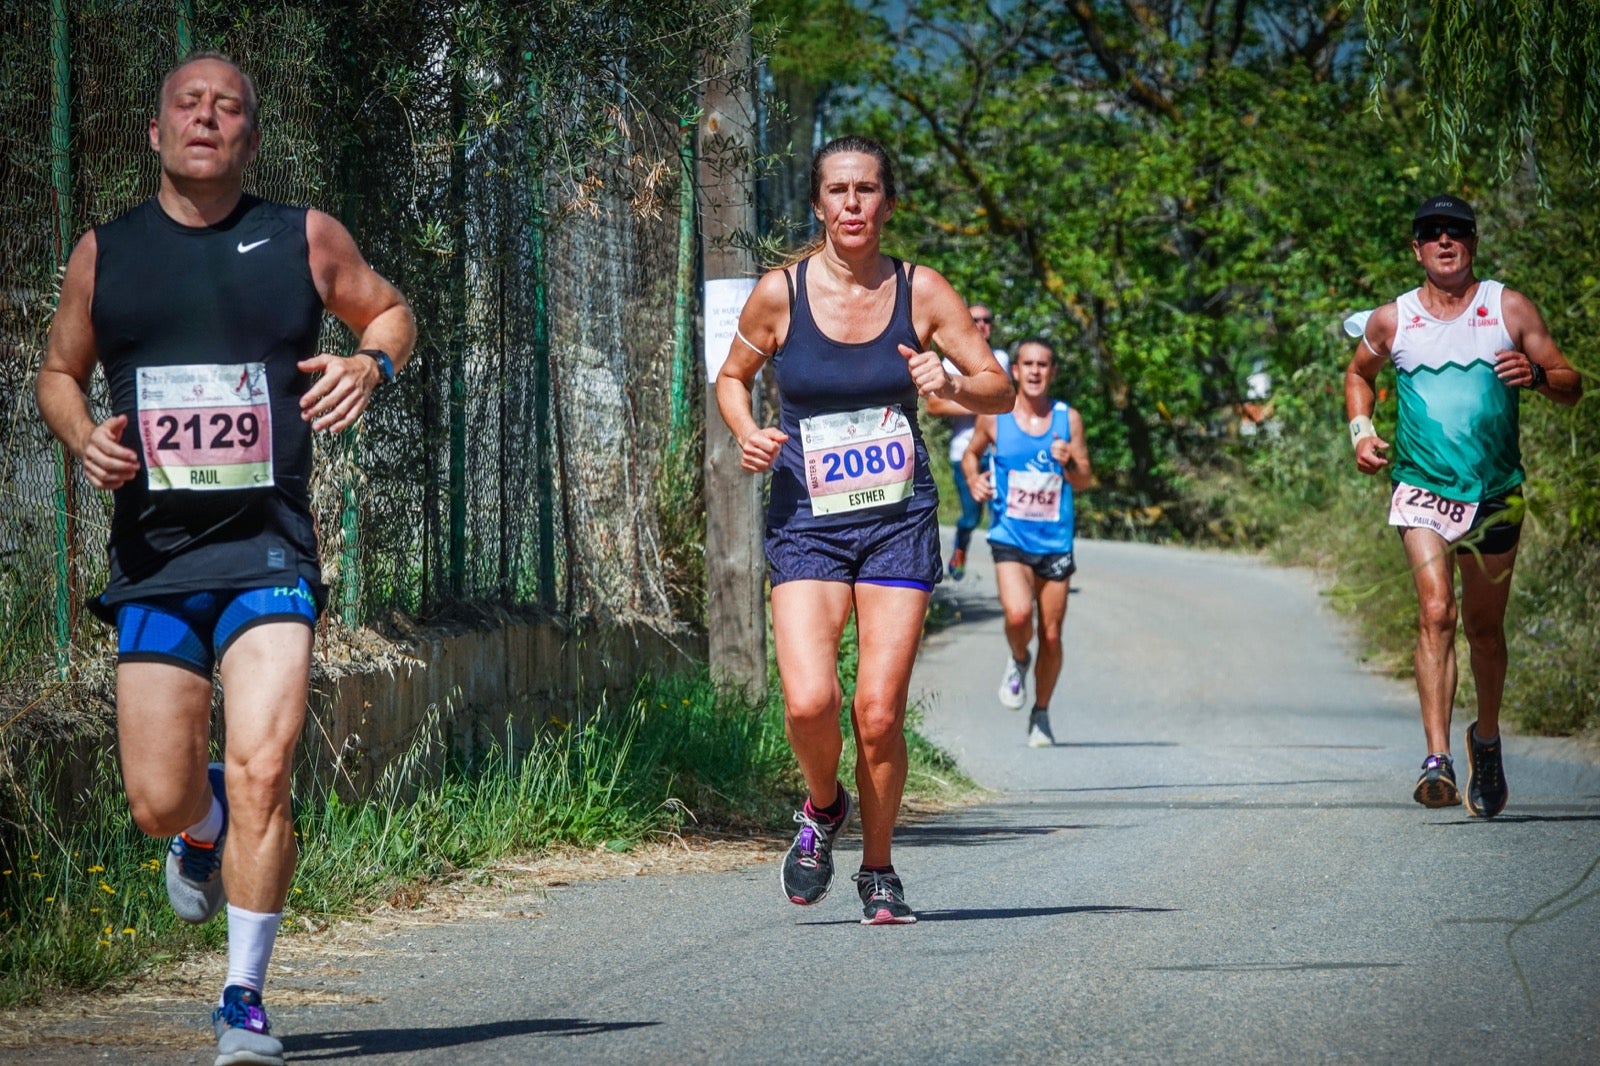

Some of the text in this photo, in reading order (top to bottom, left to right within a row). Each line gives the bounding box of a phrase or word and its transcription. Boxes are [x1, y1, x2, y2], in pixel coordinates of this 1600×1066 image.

[156, 412, 260, 450] 2129
[822, 441, 906, 483] 2080
[190, 469, 221, 485] RAUL
[848, 488, 886, 507] ESTHER
[1405, 488, 1466, 523] 2208
[1413, 515, 1442, 531] PAULINO
